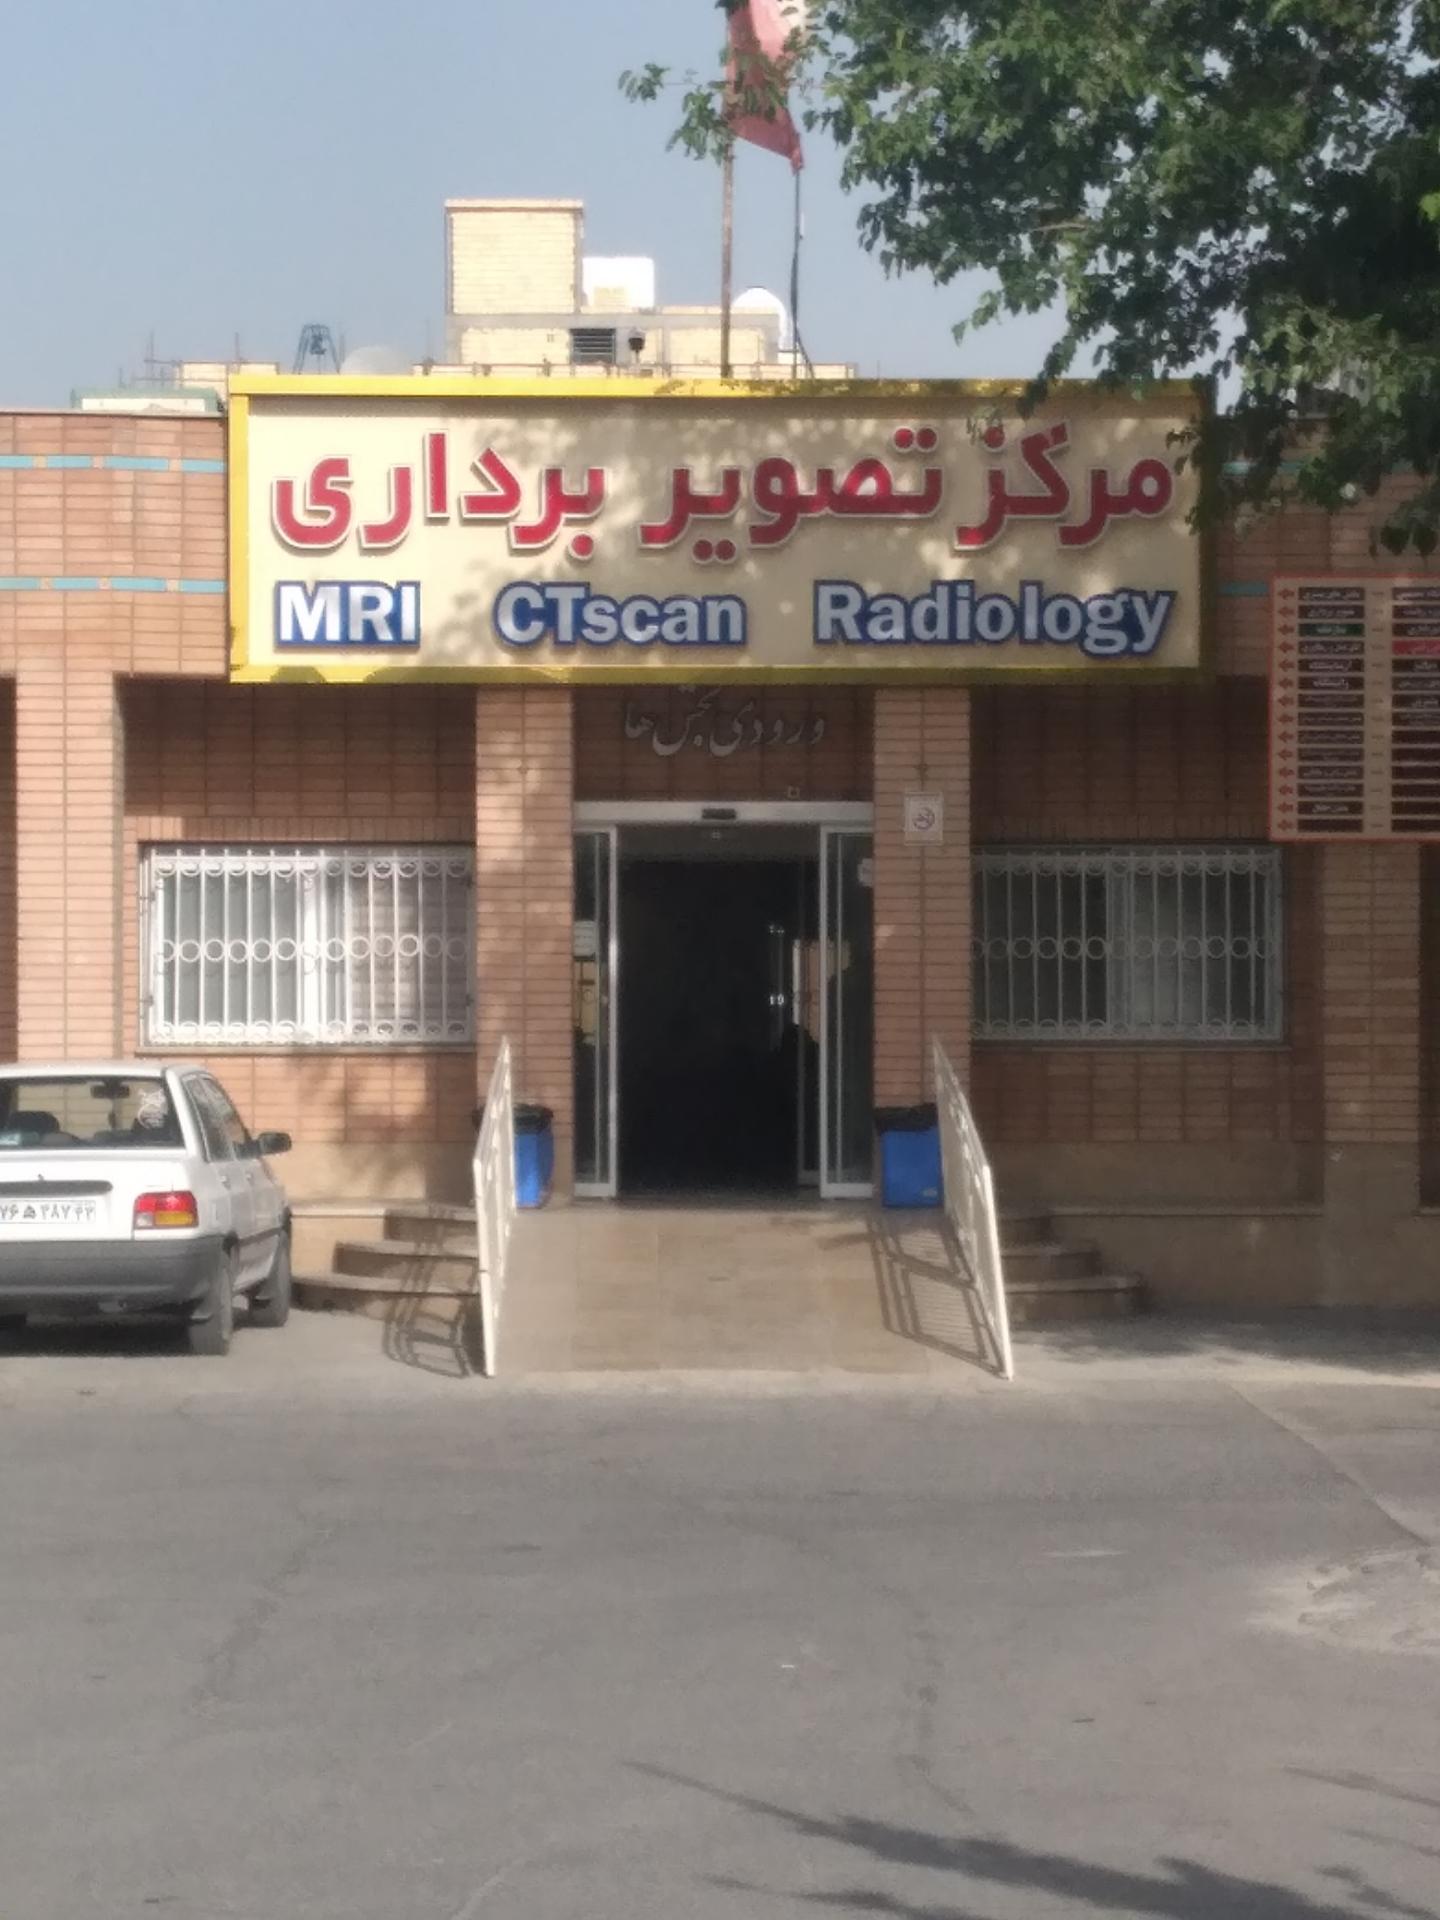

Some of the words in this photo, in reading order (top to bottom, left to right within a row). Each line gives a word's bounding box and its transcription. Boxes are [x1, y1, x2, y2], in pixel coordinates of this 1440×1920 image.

[272, 430, 606, 561] برداری
[638, 426, 944, 563] تصویر
[955, 421, 1174, 550] مرکز
[275, 581, 420, 647] MRI
[493, 581, 747, 647] CTscan
[813, 580, 1176, 658] Radiology
